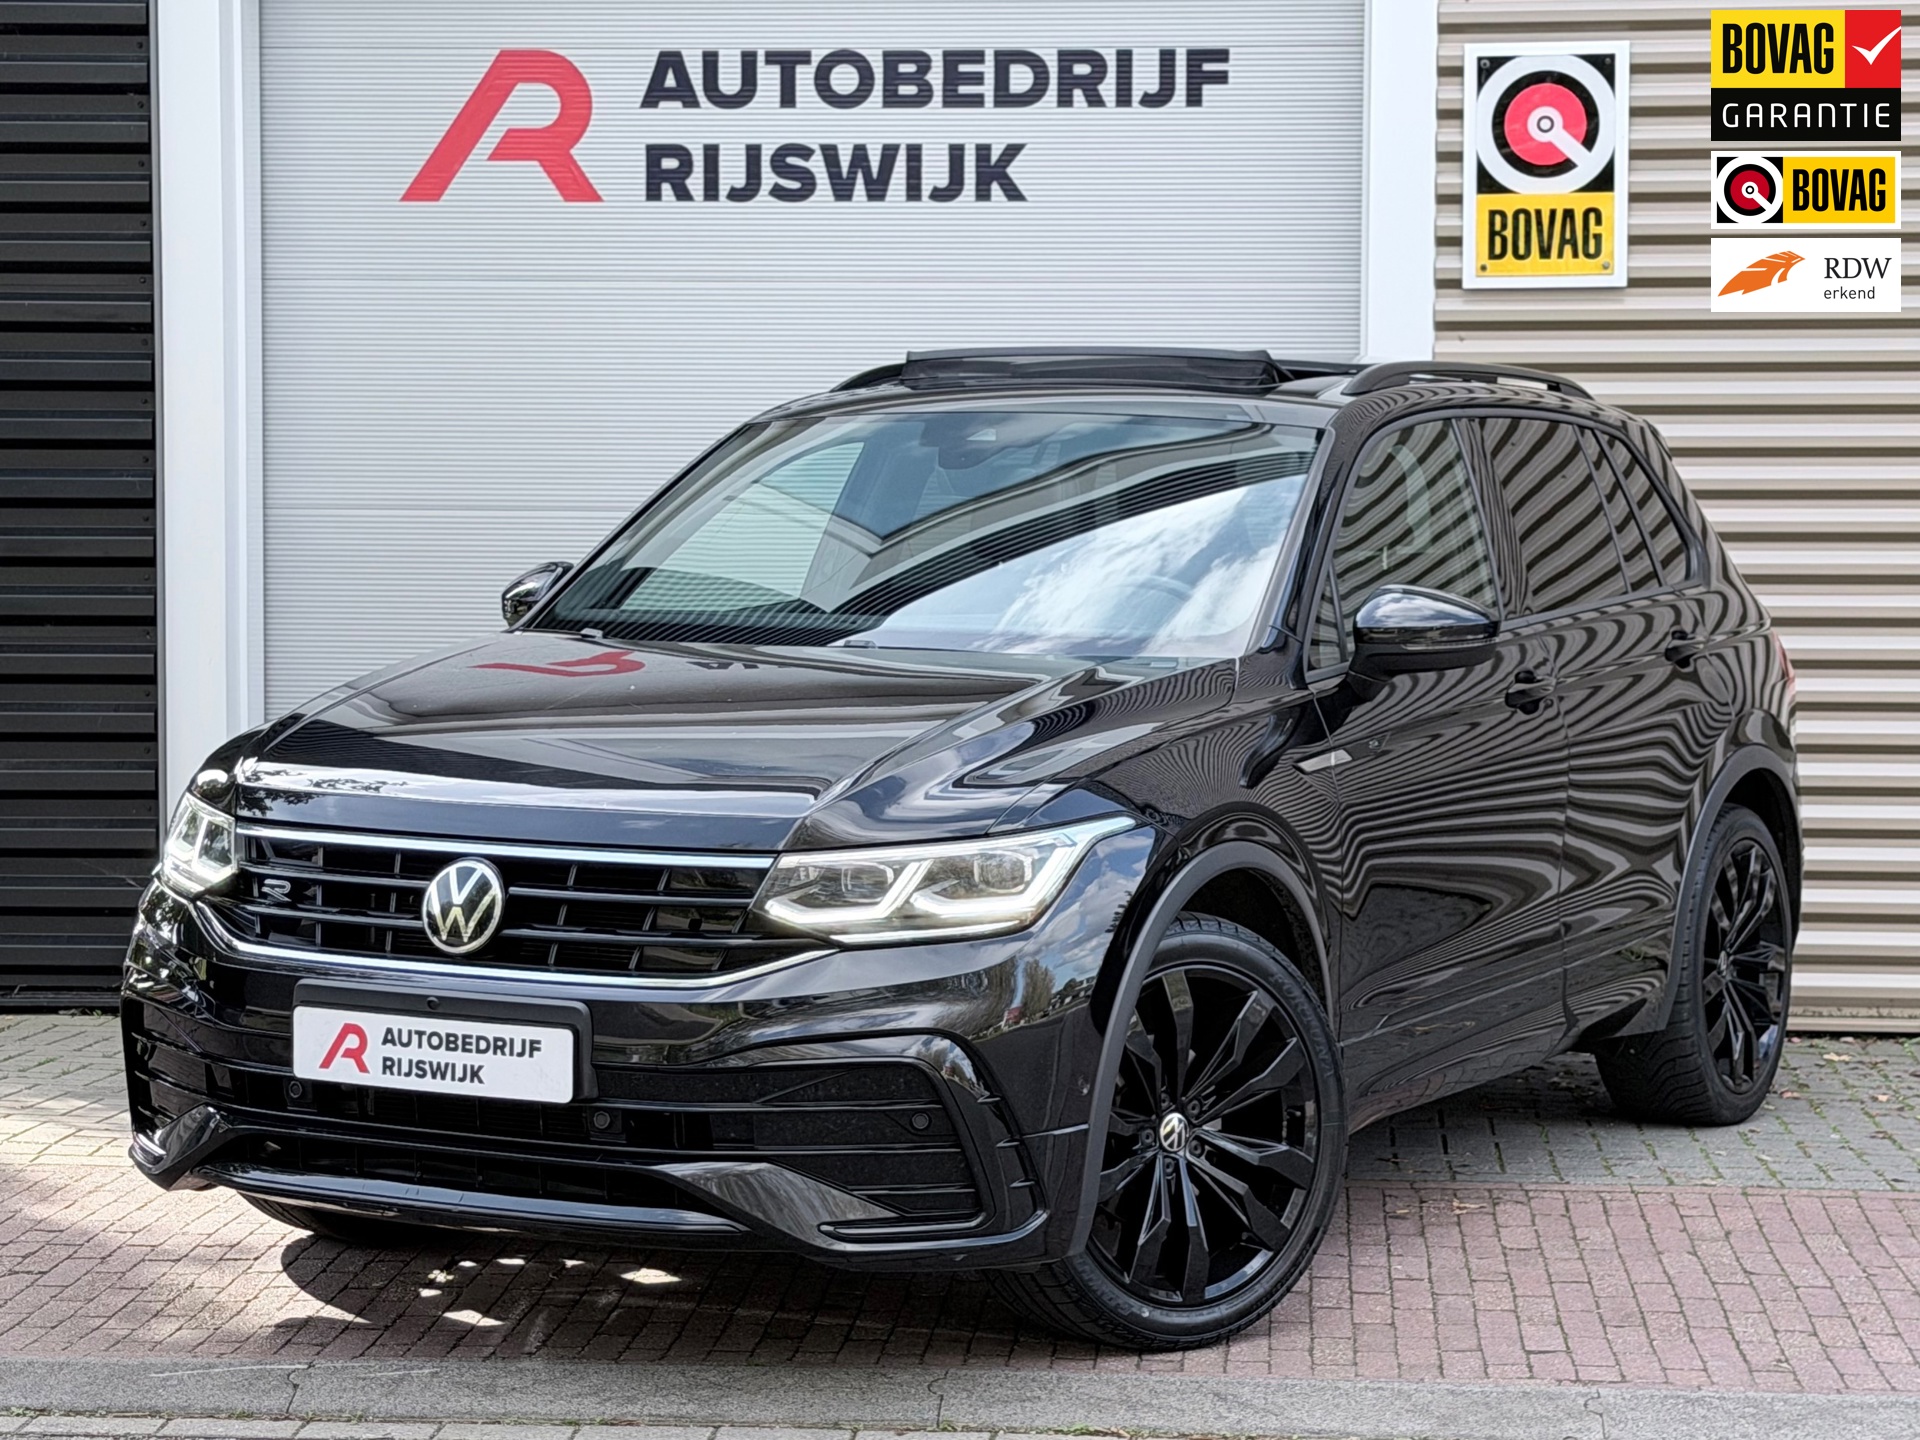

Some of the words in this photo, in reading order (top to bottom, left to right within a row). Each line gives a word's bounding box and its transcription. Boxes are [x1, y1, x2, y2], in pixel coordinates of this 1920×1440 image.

[640, 48, 1230, 109] AUTOBEDRIJF
[645, 144, 1027, 203] RIJSWIJK
[1488, 207, 1603, 260] BOVAG
[381, 1026, 542, 1059] AUTOBEDRIJF
[381, 1056, 485, 1085] RIJSWIJK
